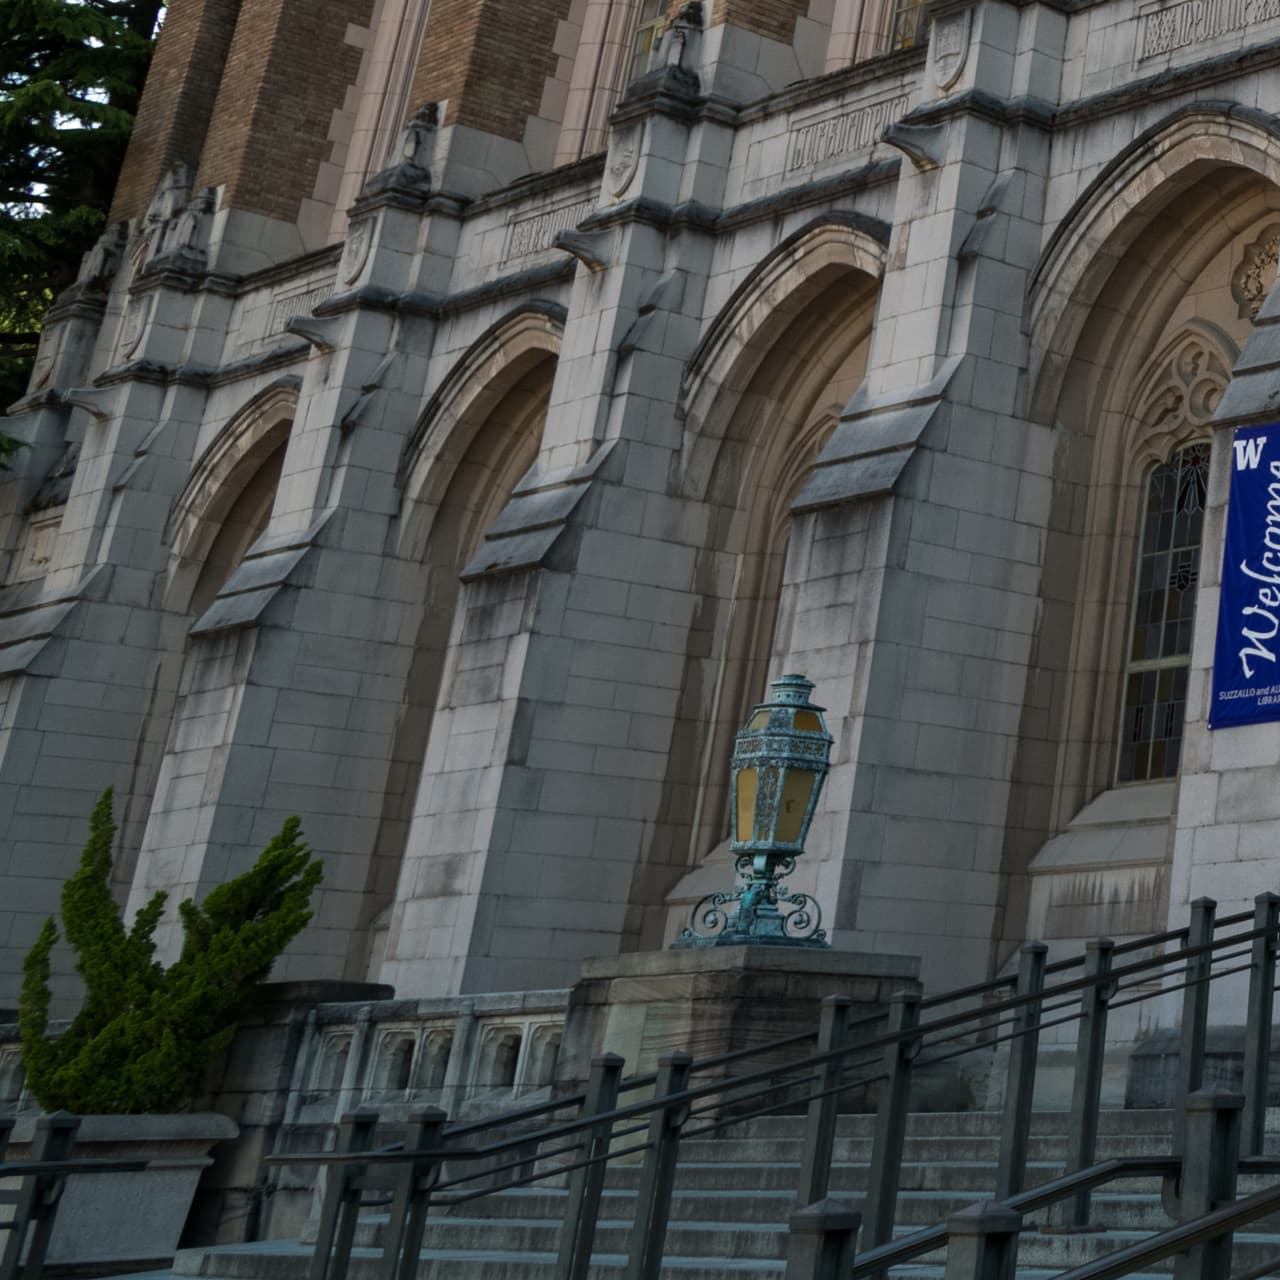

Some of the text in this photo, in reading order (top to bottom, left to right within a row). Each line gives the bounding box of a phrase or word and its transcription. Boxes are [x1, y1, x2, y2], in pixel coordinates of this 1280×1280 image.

[1233, 436, 1267, 470] W
[1218, 687, 1256, 701] SUZZALLO
[1256, 685, 1270, 696] and
